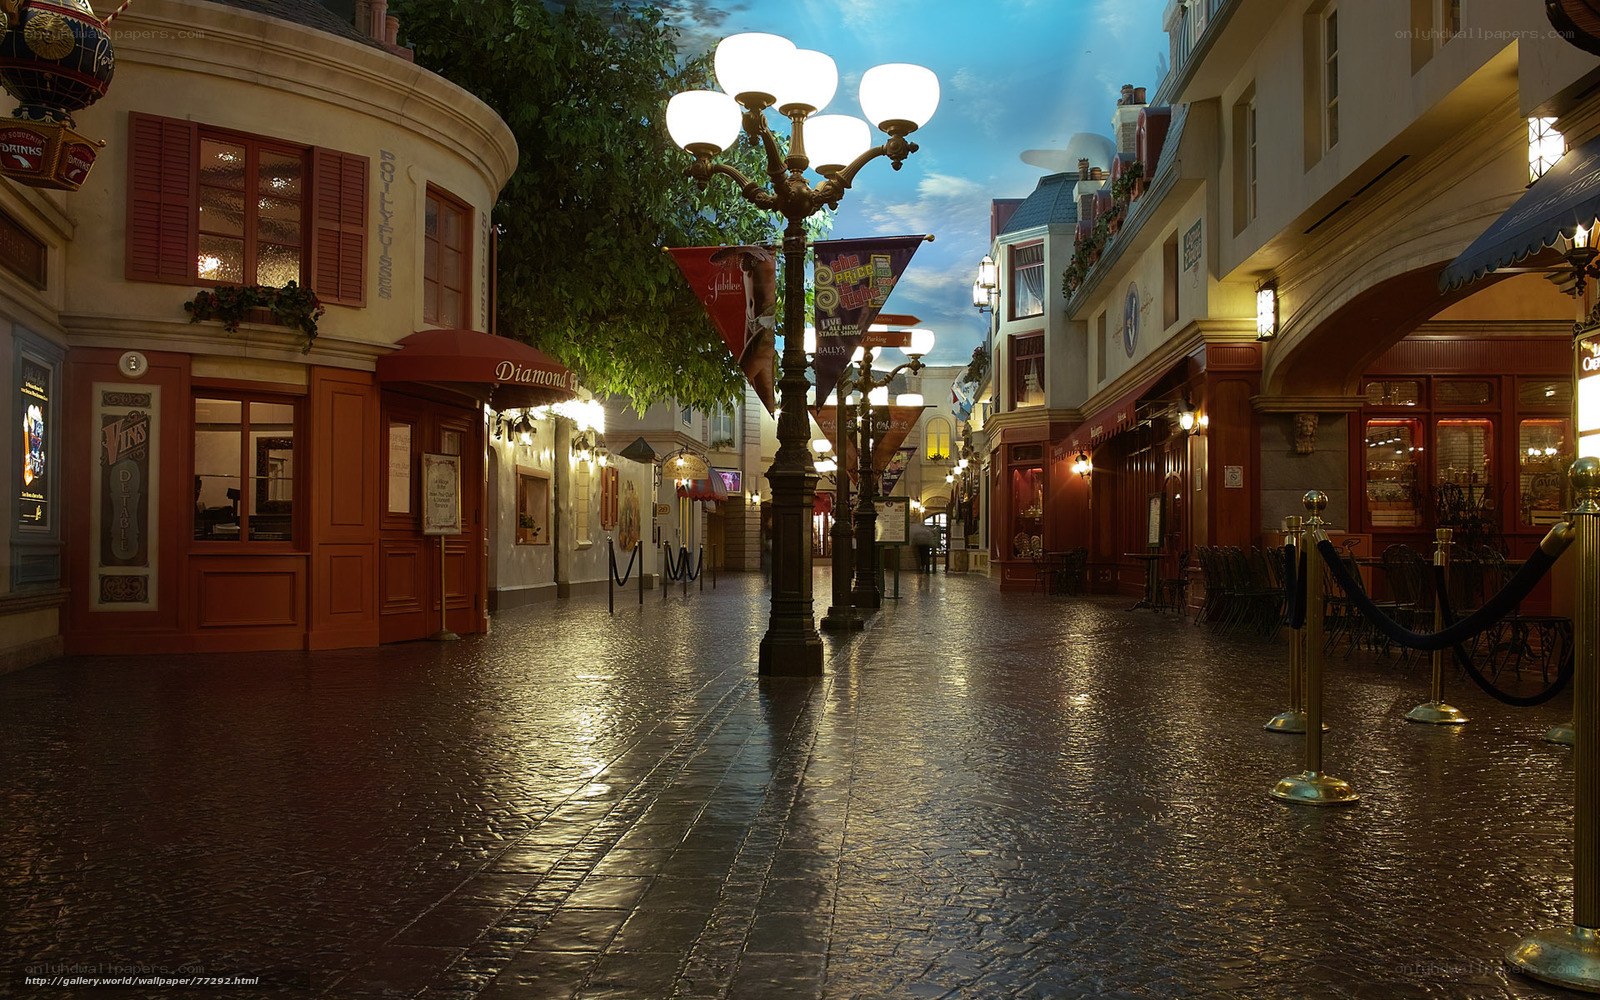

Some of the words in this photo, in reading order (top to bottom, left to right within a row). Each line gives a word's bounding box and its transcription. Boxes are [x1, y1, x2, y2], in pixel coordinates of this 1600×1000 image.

[1, 142, 43, 157] DRINKS
[821, 318, 842, 330] LIVE
[841, 329, 862, 337] SHOW
[818, 346, 846, 354] BALLY'S
[495, 360, 570, 388] Diamond
